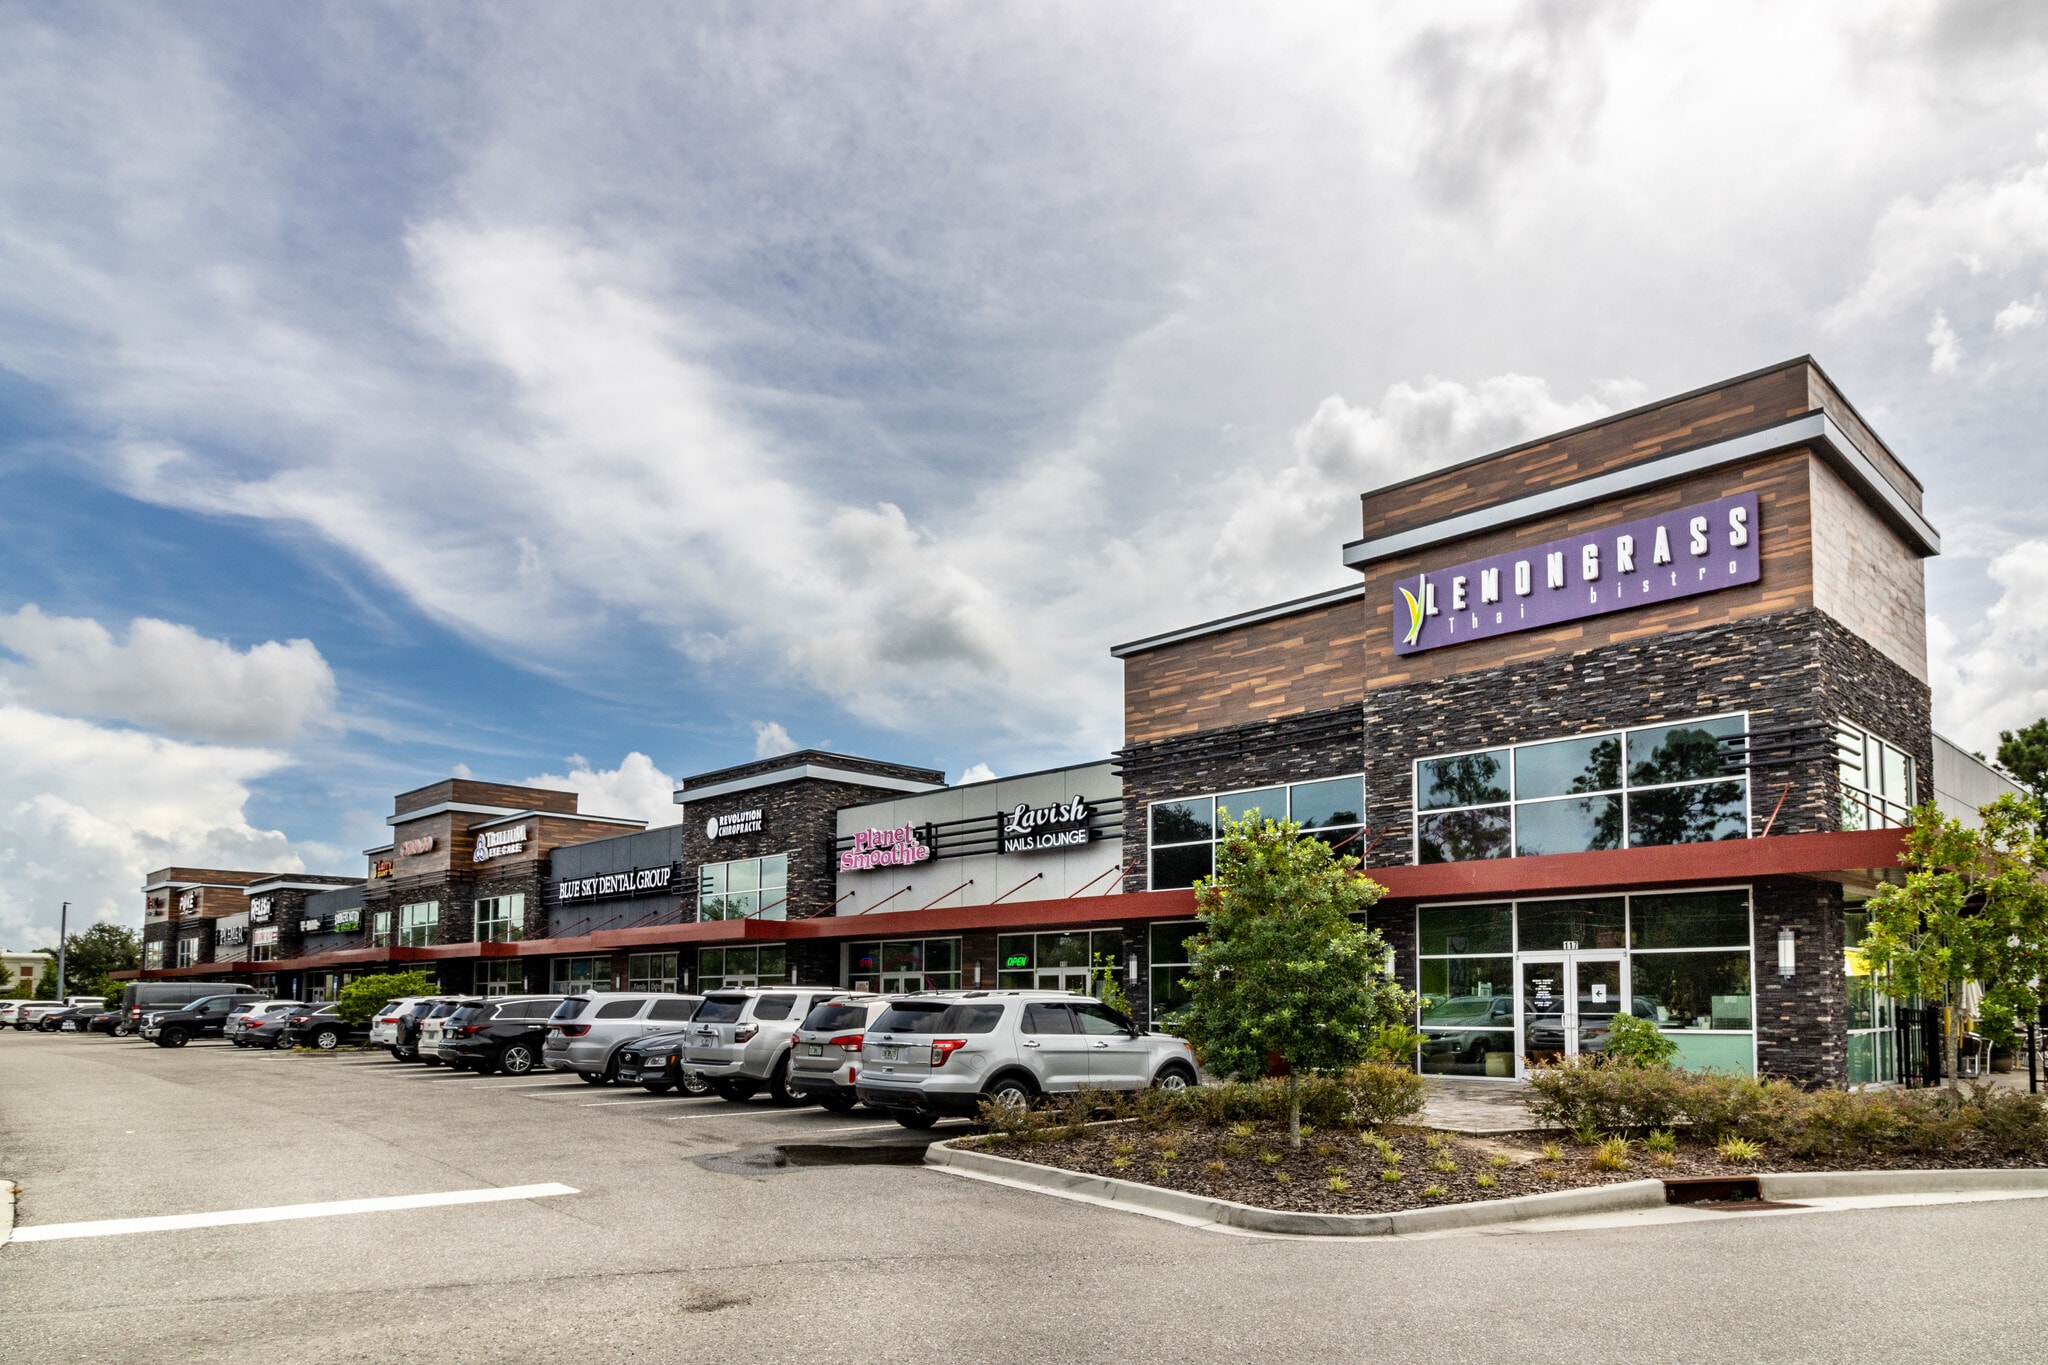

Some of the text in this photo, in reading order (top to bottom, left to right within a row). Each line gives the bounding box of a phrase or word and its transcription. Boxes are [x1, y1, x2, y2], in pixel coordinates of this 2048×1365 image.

[1426, 507, 1747, 616] LEMONGRASS
[1448, 560, 1737, 634] Thai bistro
[719, 809, 762, 826] REVOLUTION
[1003, 795, 1088, 834] Lavish
[485, 824, 528, 848] TRILLIUM
[718, 820, 762, 838] CHIROPRACTIC
[853, 821, 914, 855] Planet
[1004, 829, 1086, 852] NAILS LOUNGE
[840, 841, 930, 872] Smoothie
[558, 867, 671, 899] BLUE SKY DENTAL GROUP
[1563, 941, 1578, 950] 117
[1007, 956, 1027, 967] OPEN
